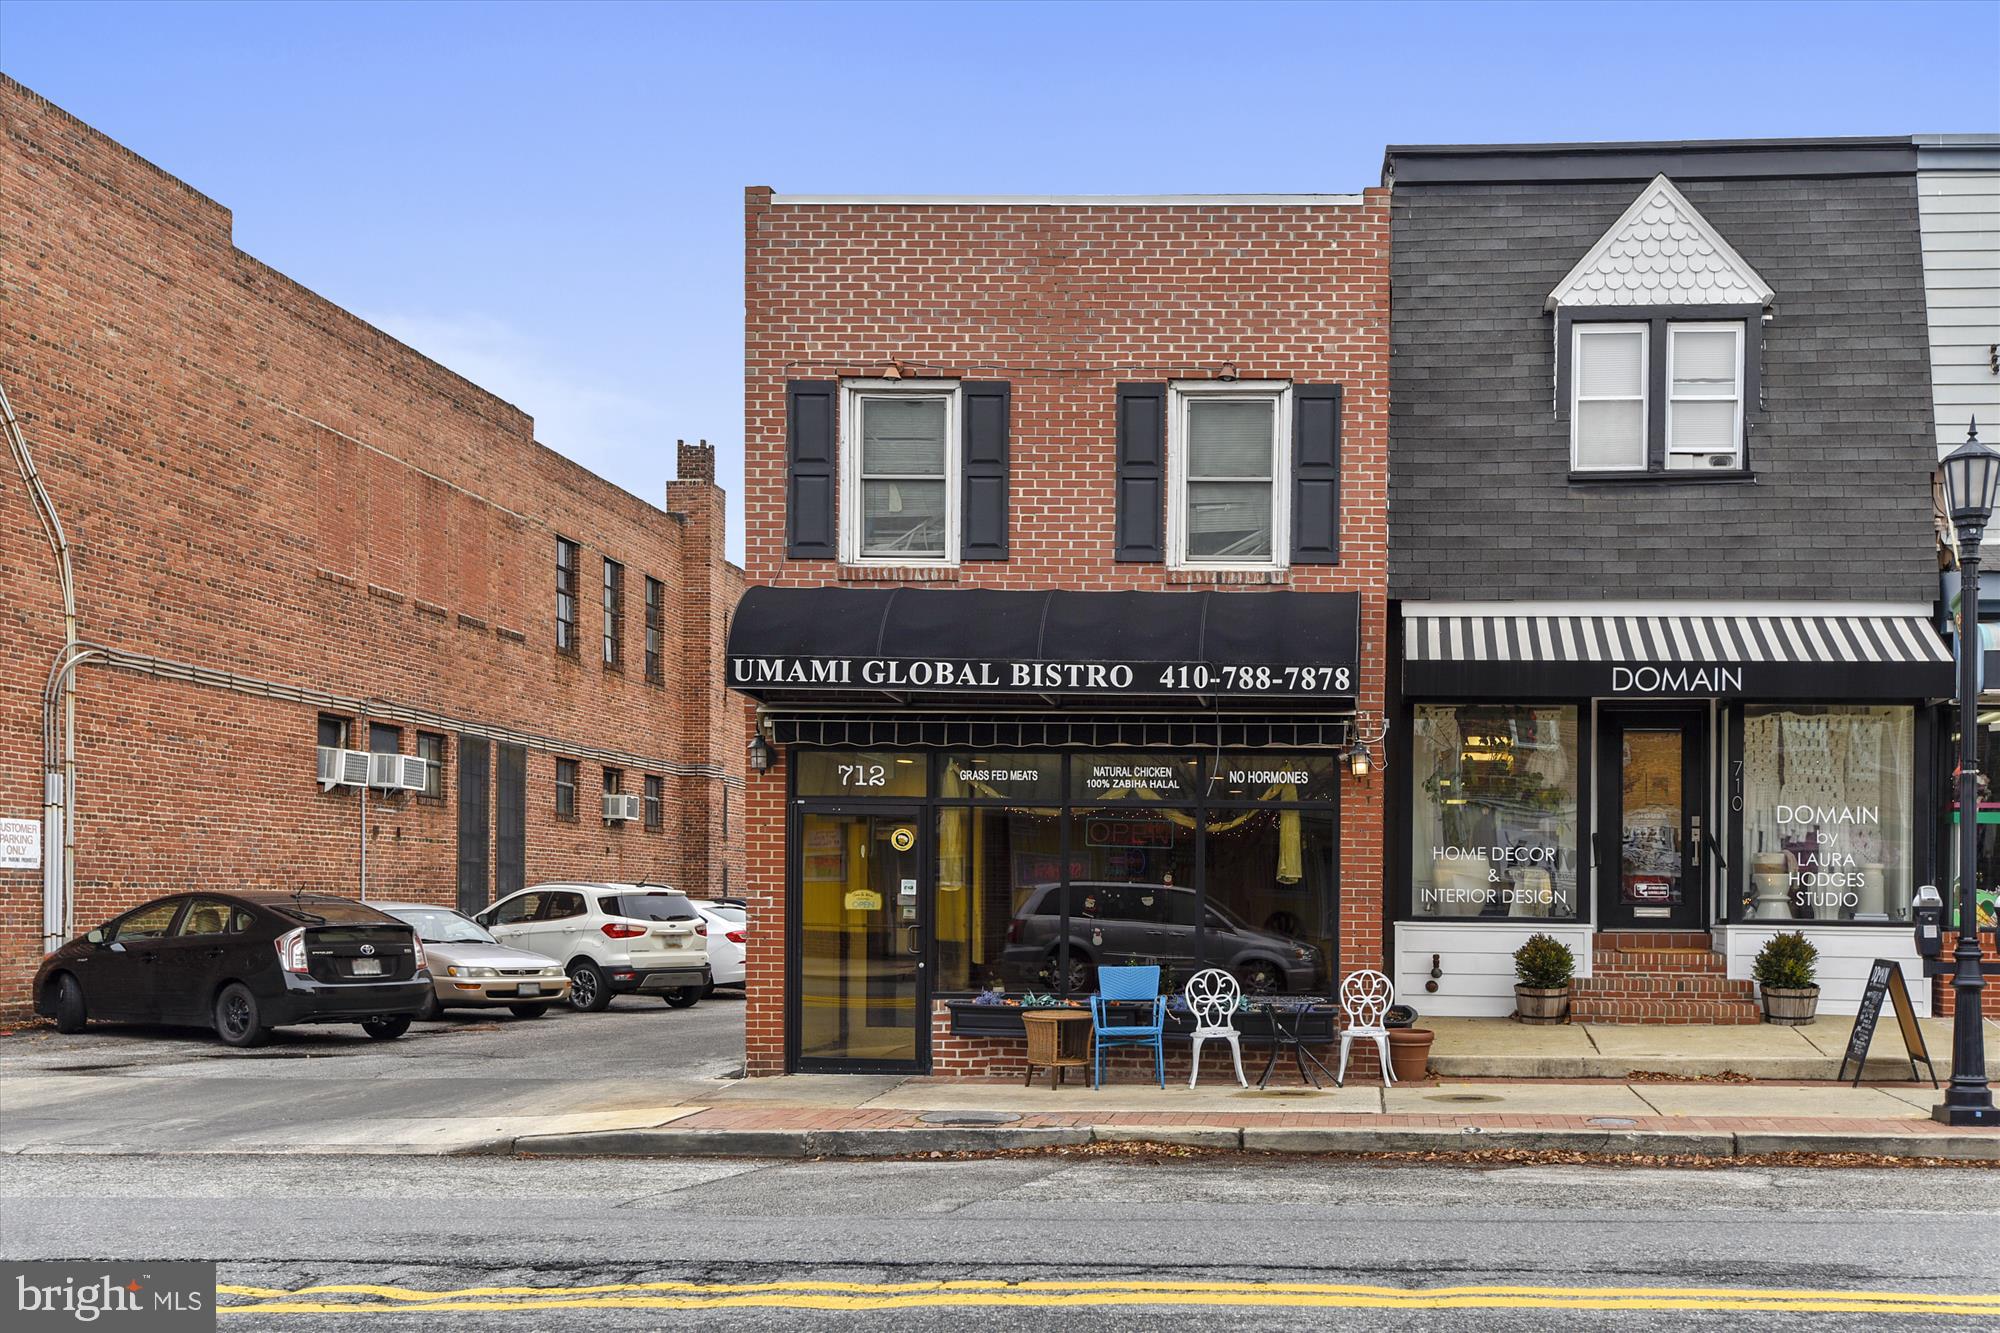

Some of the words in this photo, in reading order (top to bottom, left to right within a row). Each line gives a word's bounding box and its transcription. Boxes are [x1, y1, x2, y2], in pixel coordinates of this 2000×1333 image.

[733, 658, 852, 682] UMAMI
[862, 660, 1000, 686] GLOBAL
[1010, 663, 1134, 688] BISTRO
[1159, 665, 1350, 690] 410-788-7878
[1612, 666, 1742, 692] DOMAIN
[838, 765, 885, 786] 712
[960, 770, 990, 781] GRASS
[991, 770, 1008, 781] FED
[1010, 770, 1038, 781] MEATS
[1093, 766, 1132, 777] NATURAL
[1134, 766, 1172, 778] CHICKEN
[1229, 771, 1246, 784] NO
[1247, 771, 1309, 784] HORMONES
[1086, 779, 1110, 788] 100%
[1112, 779, 1148, 788] ZABIHA
[1149, 780, 1180, 789] HALAL
[1776, 805, 1879, 824] DOMAIN
[0, 822, 37, 834] USTOMER
[1816, 830, 1838, 847] by
[6, 845, 26, 855] ONLY
[1433, 846, 1486, 861] HOME
[1492, 846, 1555, 862] DECOR
[1797, 852, 1856, 867] LAURA
[1487, 868, 1500, 883] &
[1789, 872, 1865, 887] HODGES
[1421, 888, 1497, 903] INTERIOR
[1502, 889, 1567, 904] DESIGN
[1796, 891, 1859, 907] STUDIO
